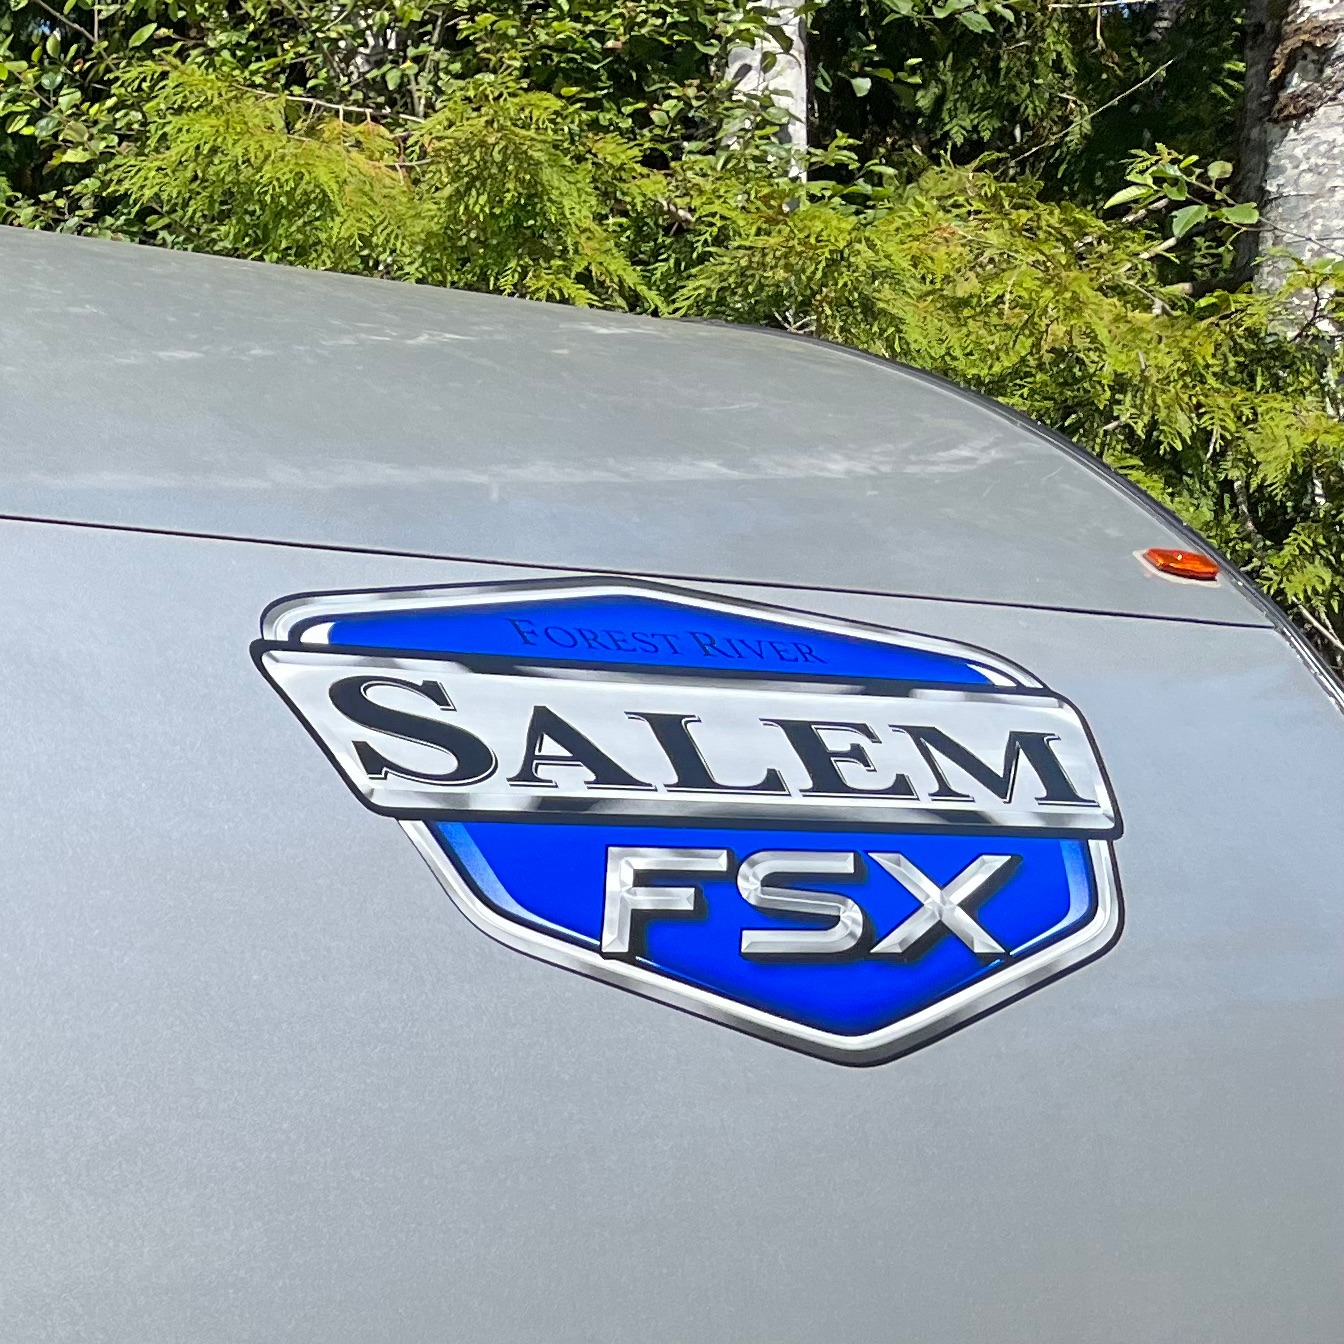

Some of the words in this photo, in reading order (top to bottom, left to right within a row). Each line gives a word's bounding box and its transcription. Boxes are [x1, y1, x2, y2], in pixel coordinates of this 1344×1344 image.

[506, 617, 680, 655] FOREST
[690, 631, 828, 665] RIVER
[327, 674, 1098, 808] SALEM
[600, 846, 1020, 958] FSX
